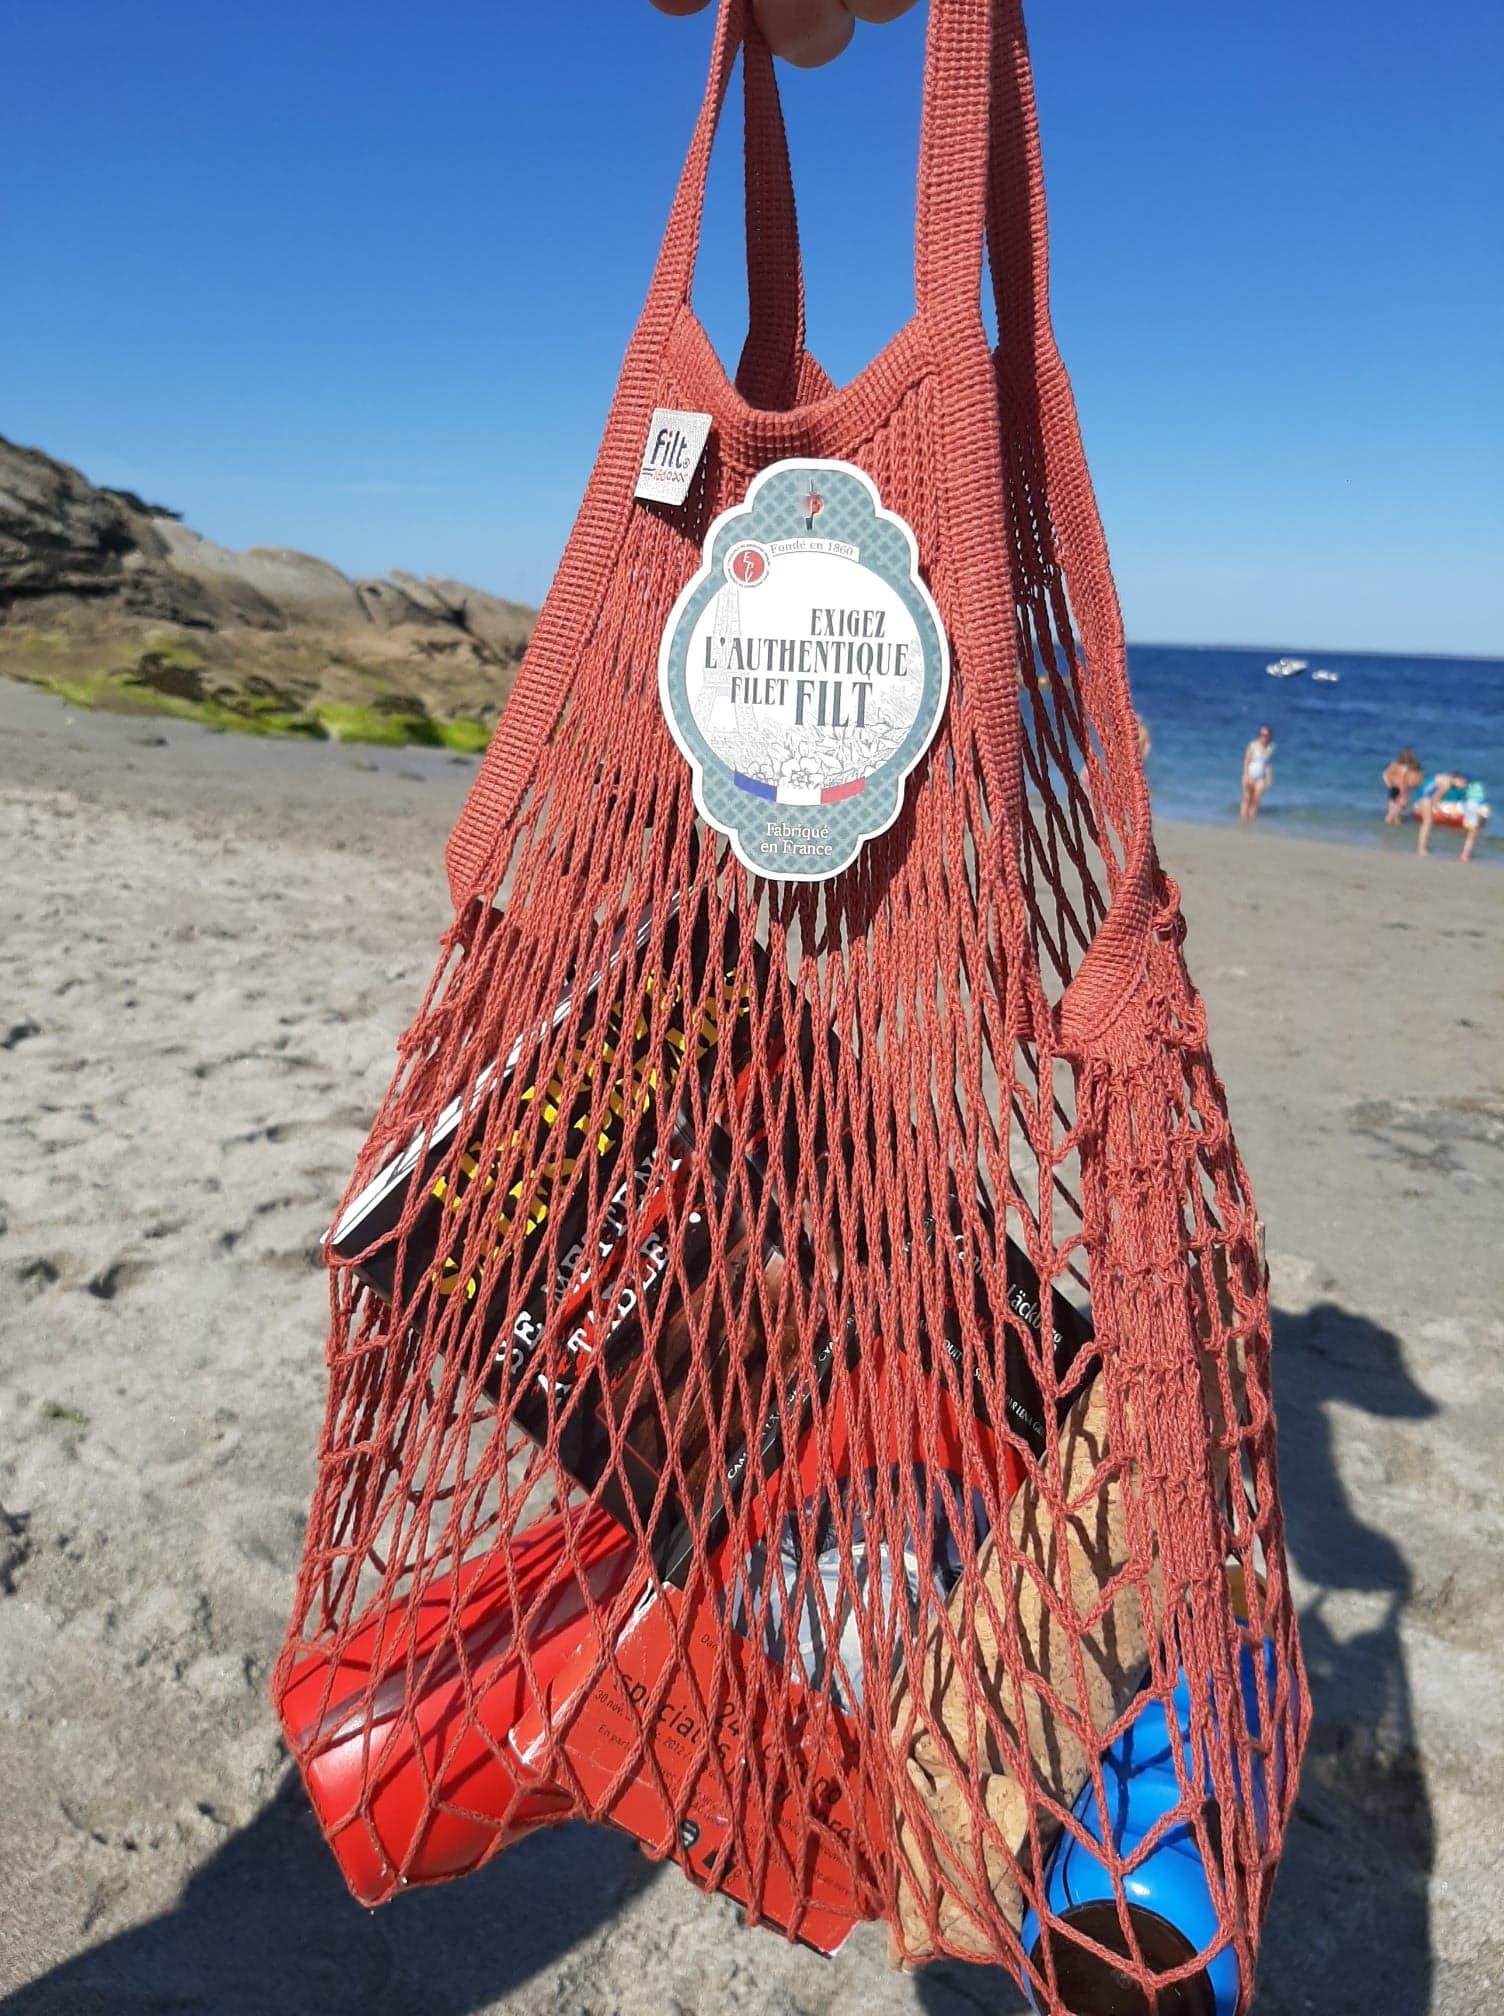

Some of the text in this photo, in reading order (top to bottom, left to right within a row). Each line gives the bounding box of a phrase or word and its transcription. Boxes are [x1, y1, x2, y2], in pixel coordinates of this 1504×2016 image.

[770, 540, 854, 556] Fondé en 1860
[810, 608, 886, 638] EXIGEZ
[704, 636, 909, 680] L'AUTHENTIQUE
[731, 676, 873, 728] FILET FILT
[766, 822, 829, 840] Fabriqué
[760, 840, 833, 856] en France
